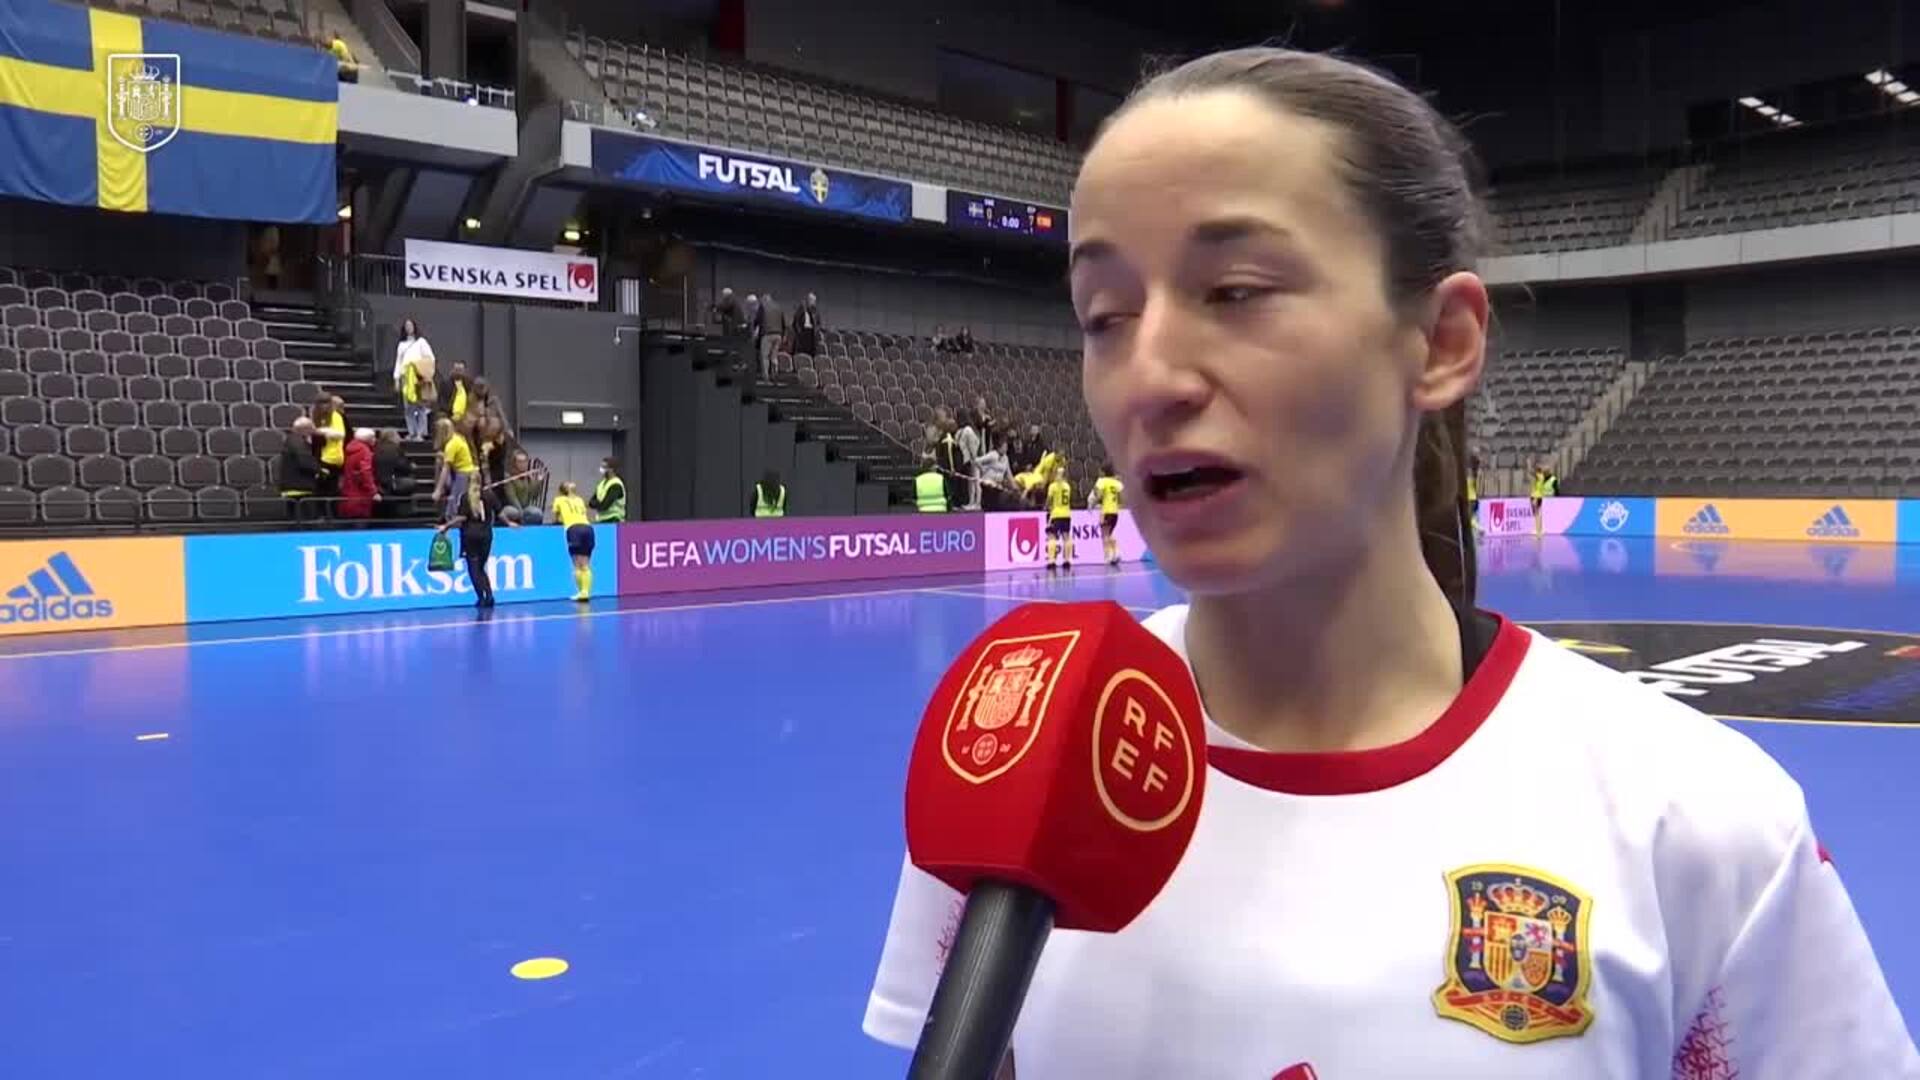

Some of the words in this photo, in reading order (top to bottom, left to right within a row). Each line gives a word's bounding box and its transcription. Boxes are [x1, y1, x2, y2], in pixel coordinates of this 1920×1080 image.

[698, 152, 801, 194] FUTSAL
[409, 262, 508, 287] SVENSKA
[515, 272, 563, 291] SPEL
[630, 541, 702, 569] UEFA
[703, 535, 826, 566] WOMEN'S
[829, 532, 918, 558] FUTSAL
[919, 529, 976, 553] EURO
[0, 596, 114, 623] adidas
